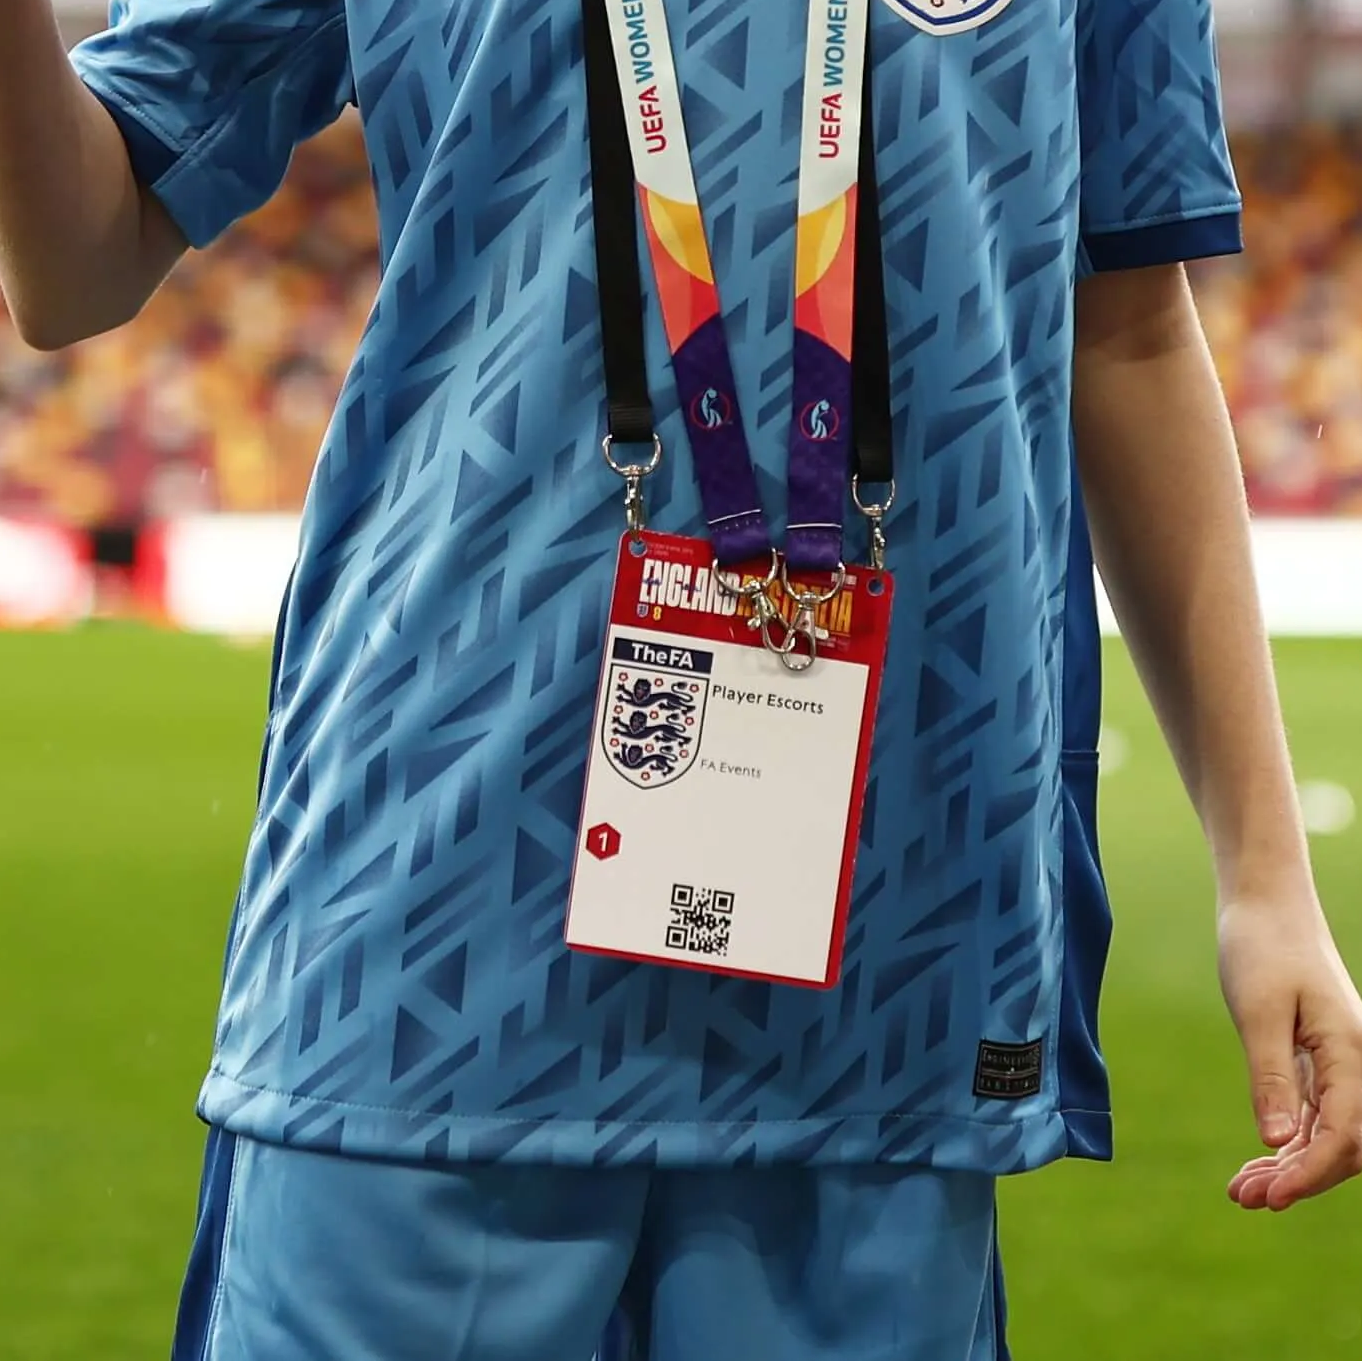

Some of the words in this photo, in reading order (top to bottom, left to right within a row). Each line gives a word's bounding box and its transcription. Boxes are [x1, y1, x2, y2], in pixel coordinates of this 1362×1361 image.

[639, 85, 667, 154] UEFA
[818, 92, 843, 159] UEFA
[640, 557, 741, 617] ENGLAND
[712, 685, 763, 706] Player
[767, 693, 825, 715] Escorts
[700, 758, 716, 771] FA
[719, 761, 762, 779] Events
[598, 831, 608, 853] 1
